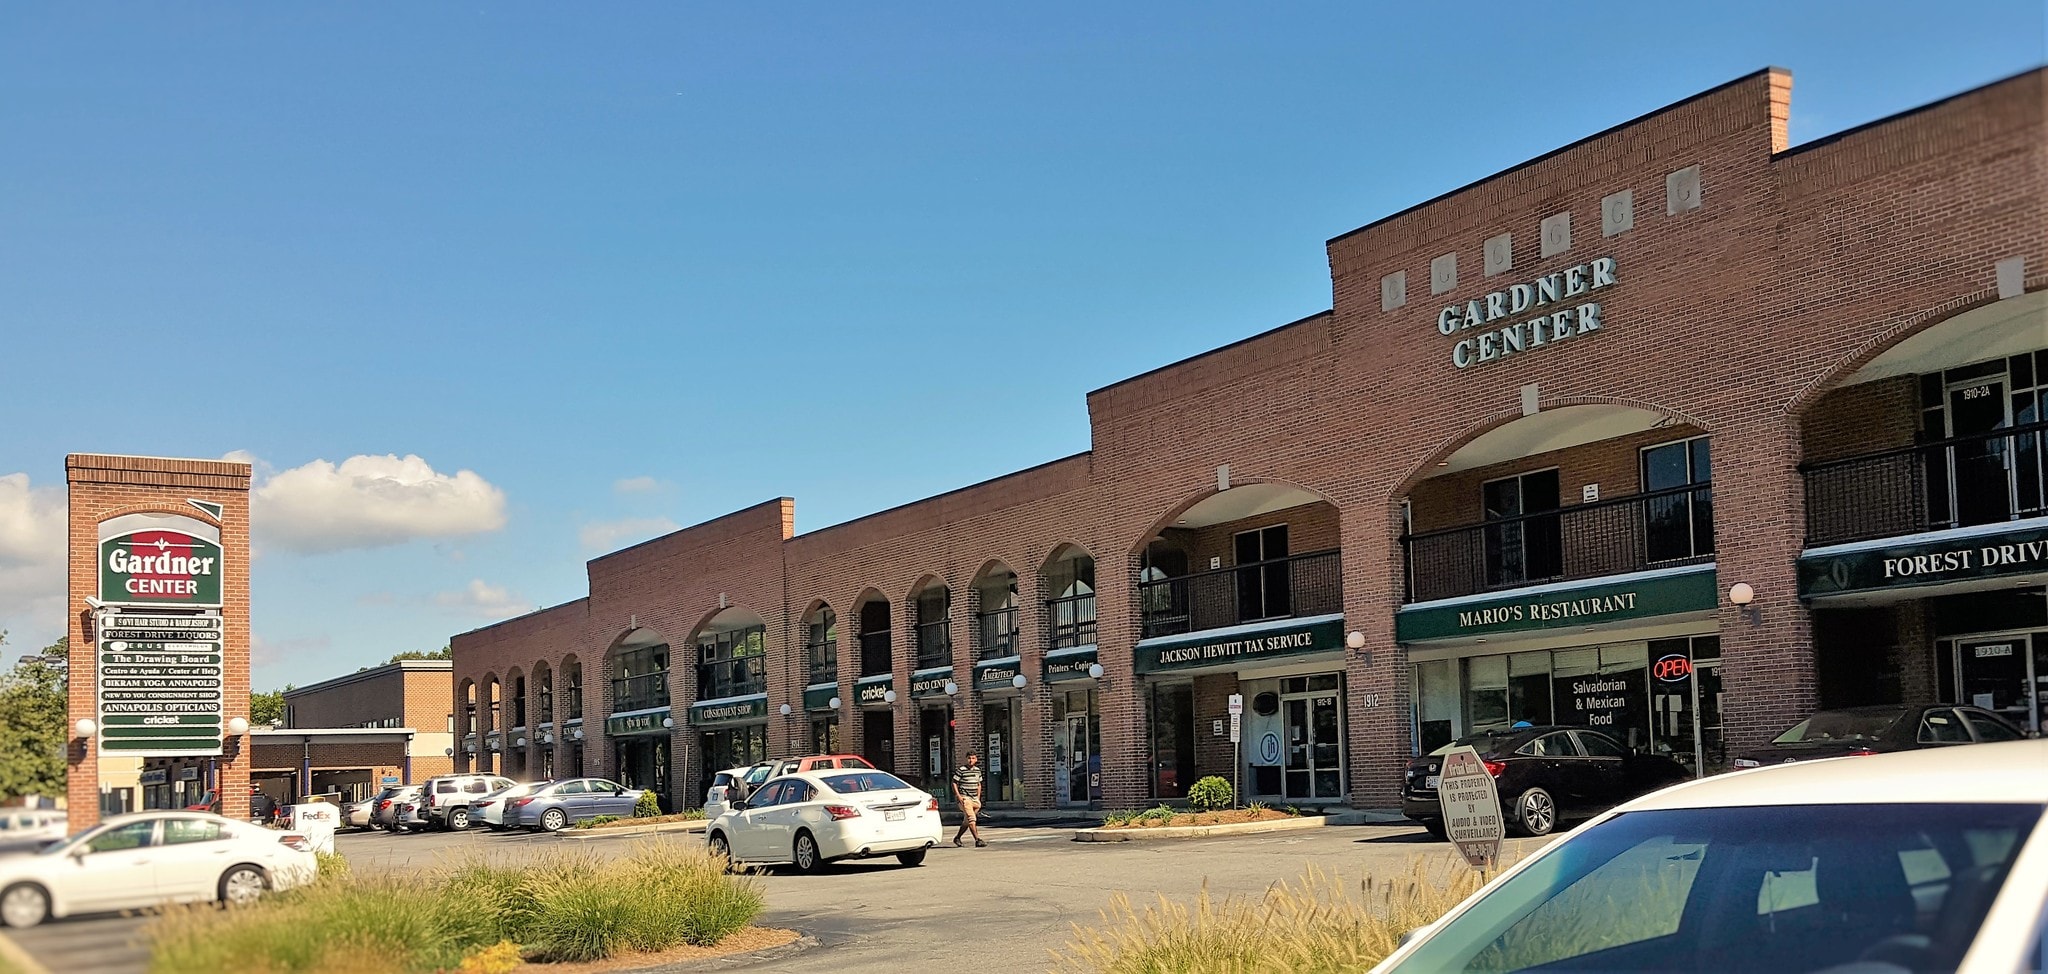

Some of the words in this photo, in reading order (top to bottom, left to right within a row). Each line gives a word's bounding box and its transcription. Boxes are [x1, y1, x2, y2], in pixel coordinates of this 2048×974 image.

[1438, 257, 1617, 336] GARDNER
[1453, 302, 1602, 369] CENTER
[1963, 386, 1991, 400] 1910-2A
[109, 548, 215, 575] Gardner
[1883, 550, 1973, 579] FOREST
[125, 578, 198, 594] CENTER
[1459, 606, 1523, 627] MARIO'S
[1530, 593, 1637, 621] RESTAURANT
[1160, 647, 1201, 664] JACKSON
[1203, 641, 1243, 659] HEWITT
[1244, 638, 1265, 653] TAX
[1266, 632, 1313, 650] SERVICE
[112, 655, 132, 663] The
[135, 655, 177, 664] Drawing
[181, 655, 210, 663] Board
[1048, 664, 1070, 674] Printers
[1654, 659, 1693, 678] OPEN
[861, 684, 886, 700] cricket
[912, 681, 930, 692] DISCO
[1573, 679, 1626, 694] Salvadorian
[1363, 693, 1379, 708] 1912
[1576, 698, 1583, 710] &
[1586, 695, 1625, 709] Mexican
[703, 707, 737, 719] CONSIGNMENT
[737, 704, 751, 715] SHOP
[1589, 711, 1612, 726] Food
[143, 715, 180, 724] cricket
[1445, 780, 1459, 791] THIS
[1461, 778, 1487, 789] PROPERTY
[1450, 793, 1457, 803] IS
[1458, 790, 1488, 802] PROTECTED
[302, 811, 331, 820] FedEx
[1467, 804, 1476, 813] BY
[1452, 817, 1471, 828] AUDIO
[1473, 817, 1478, 826] &
[1480, 815, 1497, 825] VIDEO
[1454, 828, 1498, 840] SURVEILLANCE
